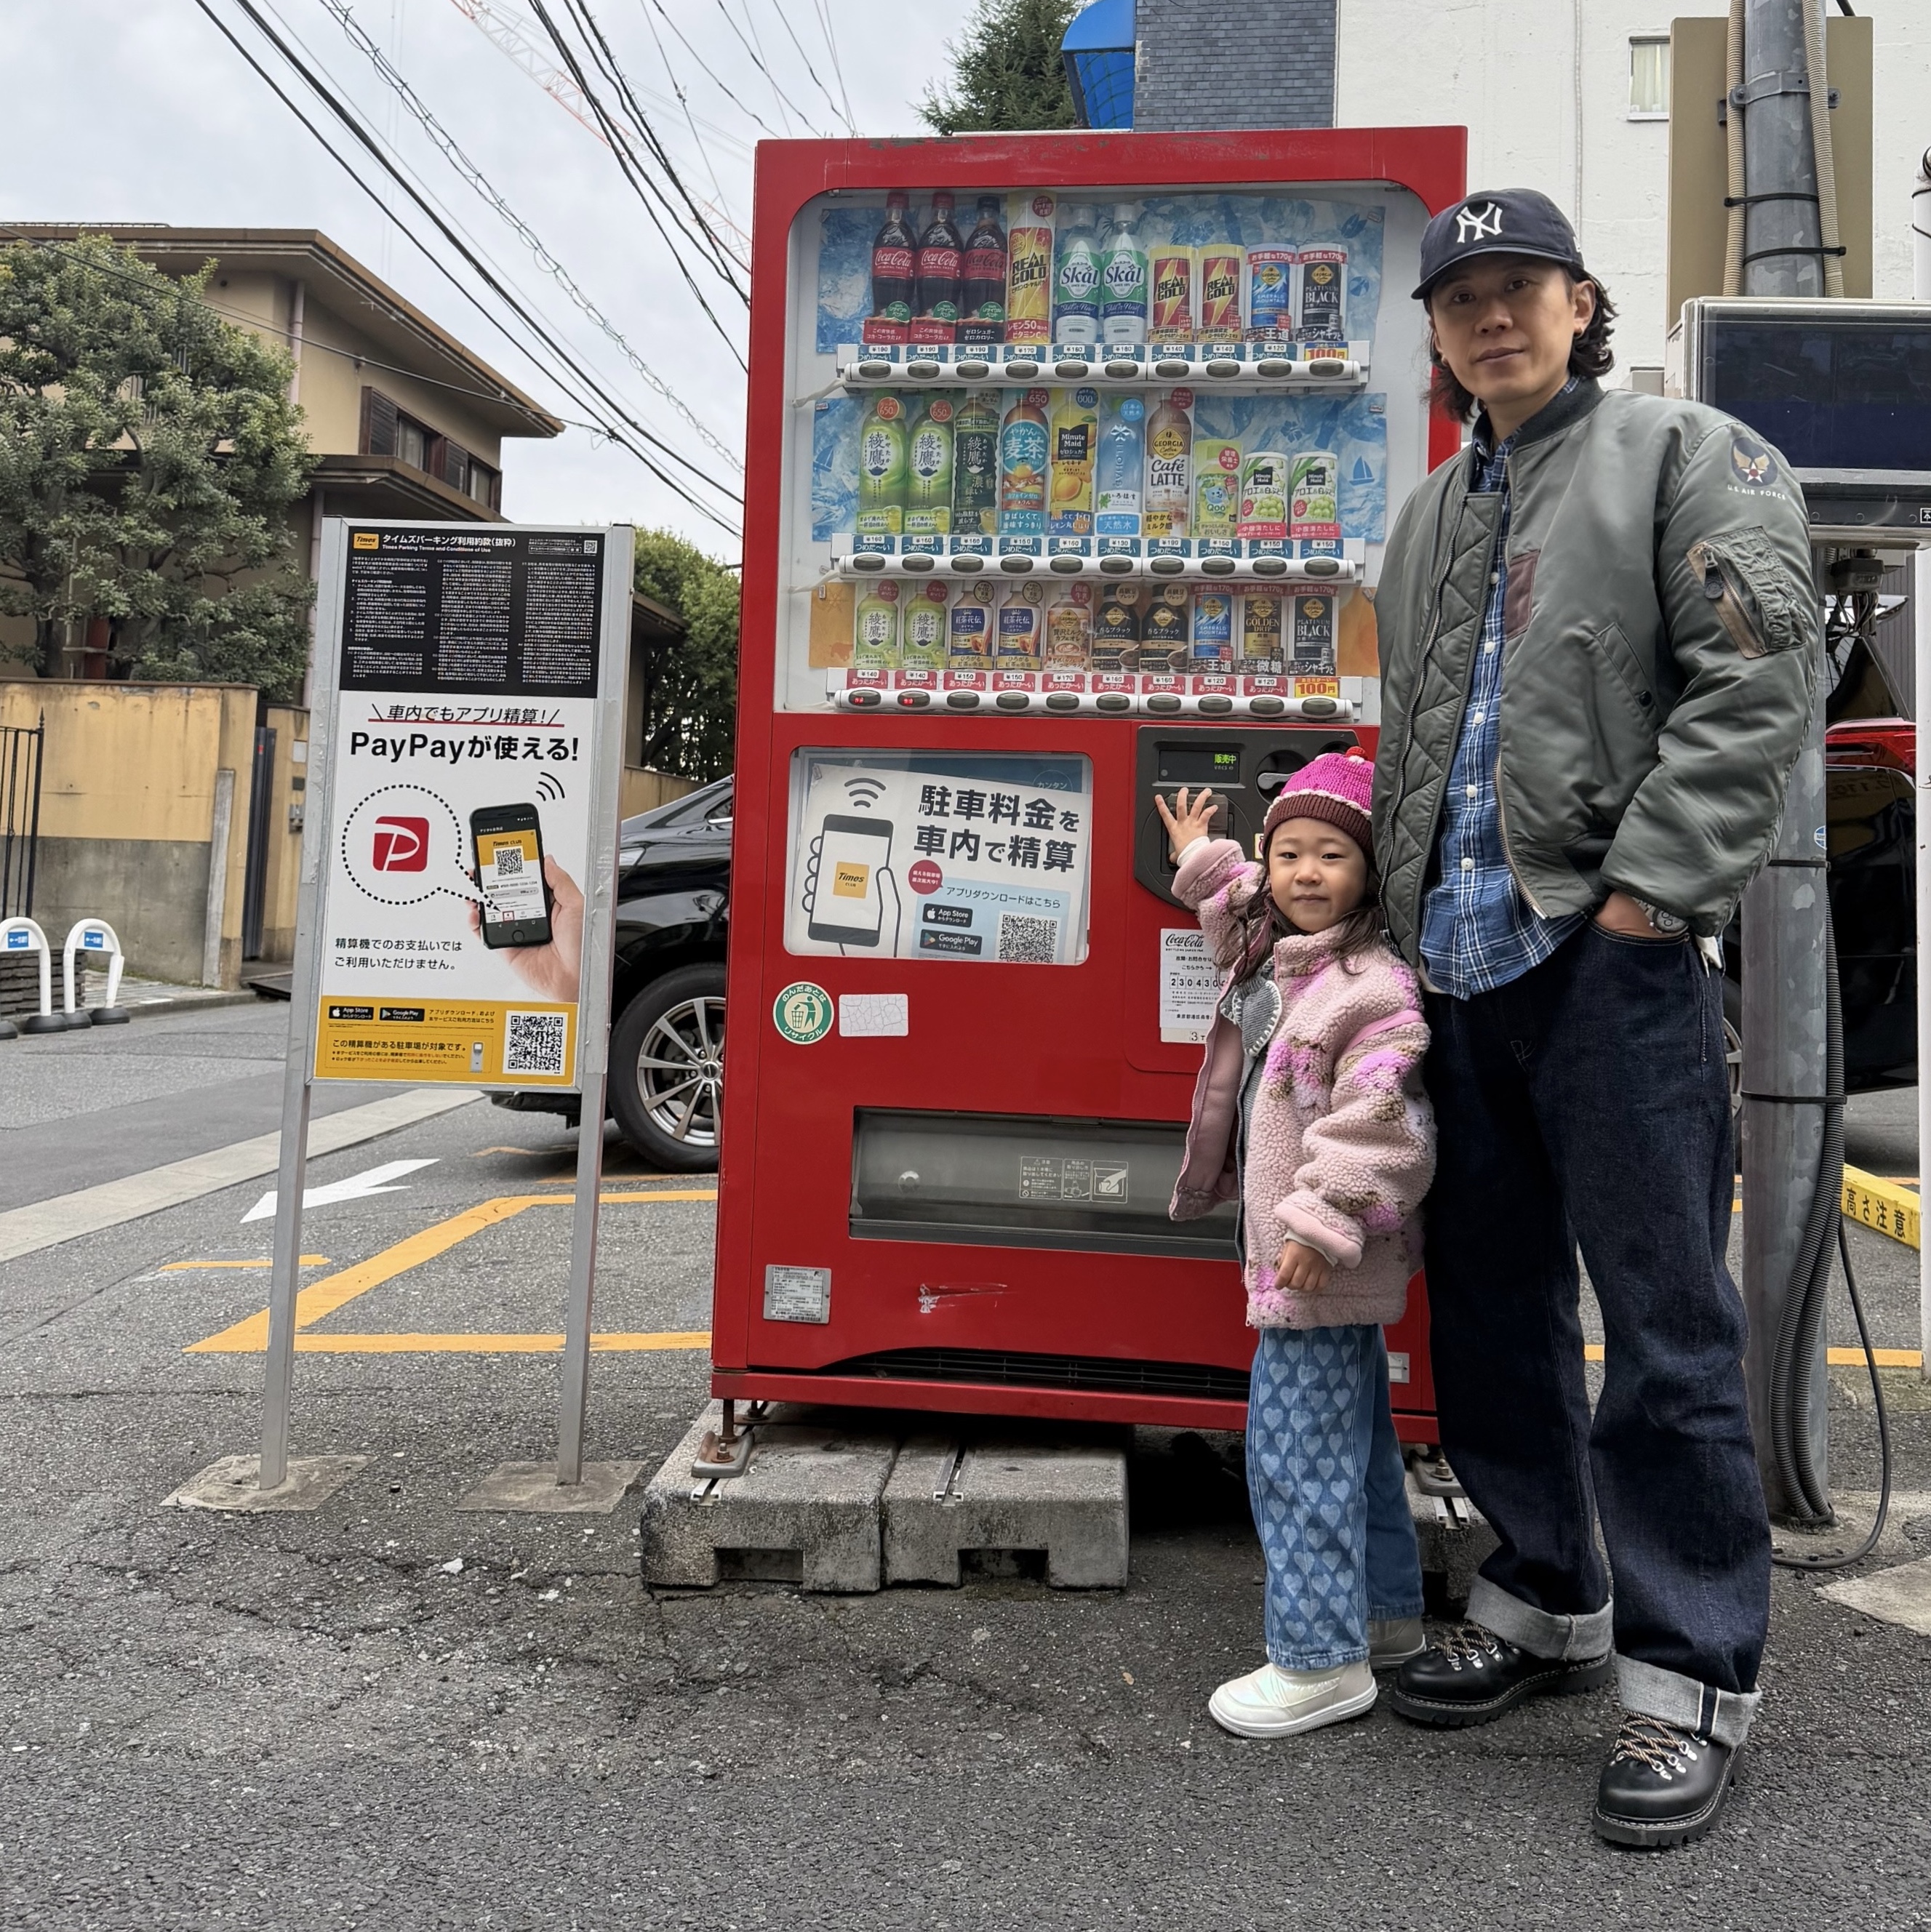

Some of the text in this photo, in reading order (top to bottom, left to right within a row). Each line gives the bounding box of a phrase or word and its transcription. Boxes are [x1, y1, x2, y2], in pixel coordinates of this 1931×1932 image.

[1456, 201, 1503, 243] NY
[1012, 252, 1047, 274] REAL
[1012, 266, 1047, 286] GOLD
[1207, 275, 1234, 291] REAL
[1158, 276, 1185, 291] REAL
[1158, 286, 1185, 301] GOLD
[1207, 286, 1234, 300] GOLD
[1306, 292, 1338, 303] BLACK
[1004, 437, 1046, 460] 麦茶
[1151, 460, 1184, 473] Café
[1151, 473, 1184, 486] LATTE
[1760, 490, 1786, 500] FORCE
[1297, 625, 1330, 637] BLACK
[1298, 684, 1335, 694] 100円
[1214, 754, 1236, 763] 販売中
[918, 785, 1079, 833] 駐車料金を
[913, 825, 1076, 873] 車内で精算
[838, 872, 865, 883] Times
[947, 886, 1060, 909] アプリダウンロードはこちら
[938, 909, 968, 919] App Store
[335, 938, 463, 952] 精算機でのお支払いでは
[939, 934, 978, 947] Google Play
[1166, 934, 1204, 947] Coca-Cola
[335, 956, 455, 970] ご利用いただけません。
[782, 985, 827, 1003] のんだあとは
[784, 1026, 823, 1041] リサイクル
[332, 1039, 466, 1051] この精算機がある駐車場が対象です。
[1846, 1187, 1906, 1239] 高さ注意
